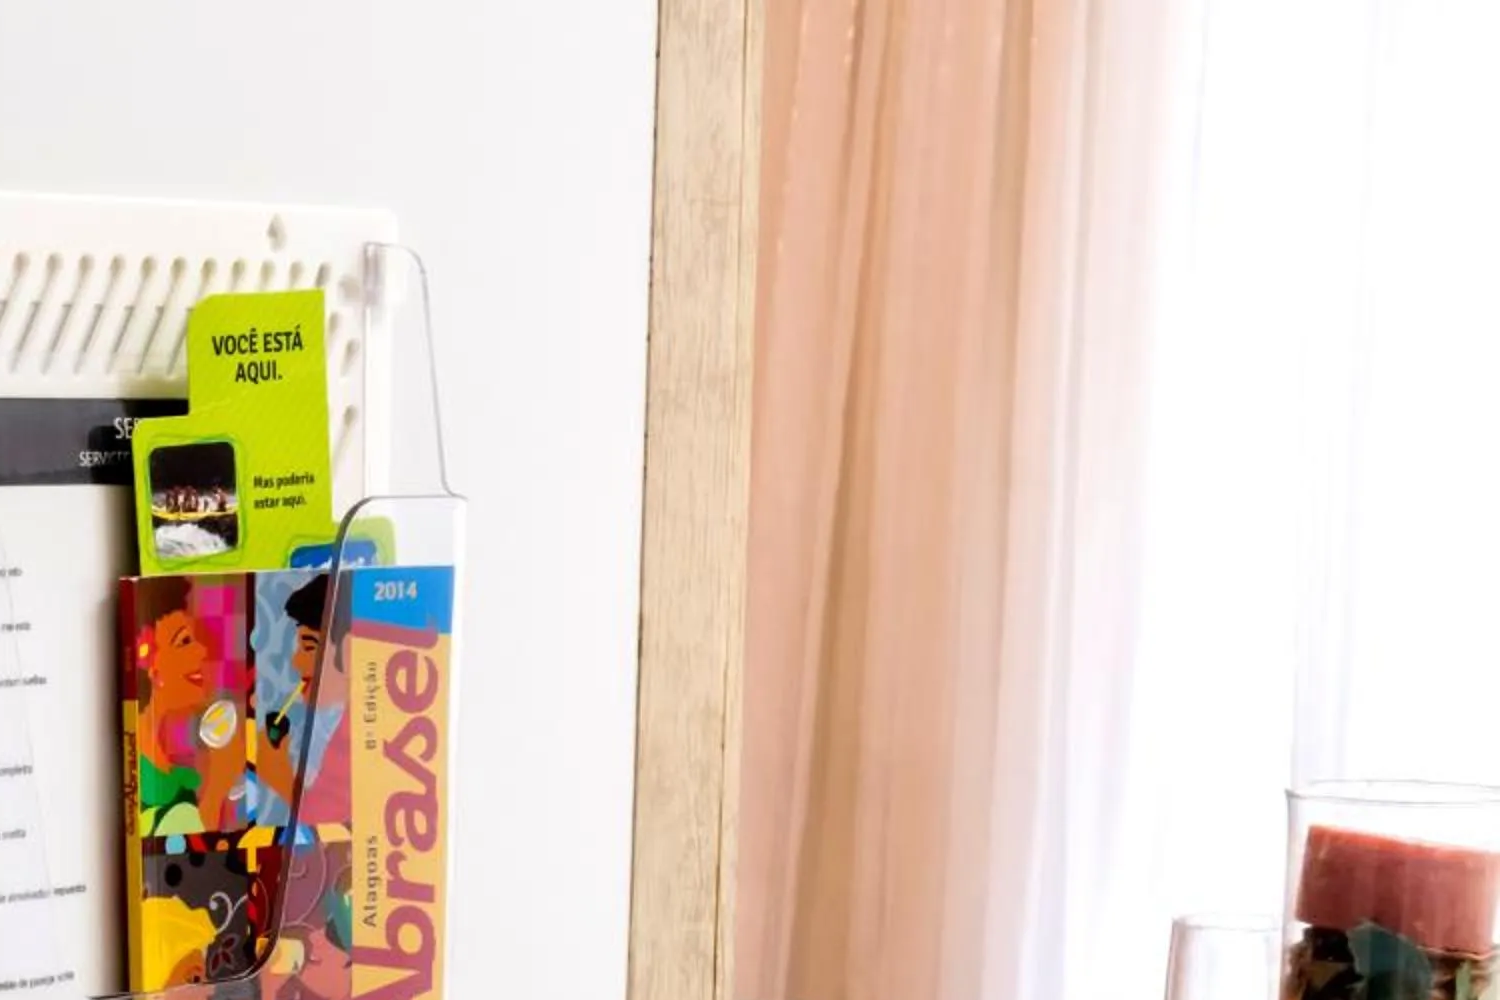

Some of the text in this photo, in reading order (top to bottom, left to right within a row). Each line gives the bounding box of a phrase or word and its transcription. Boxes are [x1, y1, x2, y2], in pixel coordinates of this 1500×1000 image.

[212, 324, 304, 356] VOCÊ ESTÁ
[235, 360, 282, 385] AQUI.
[276, 472, 315, 491] poderia
[374, 581, 417, 601] 2014
[364, 661, 380, 727] Edição
[363, 836, 380, 928] Alagoas
